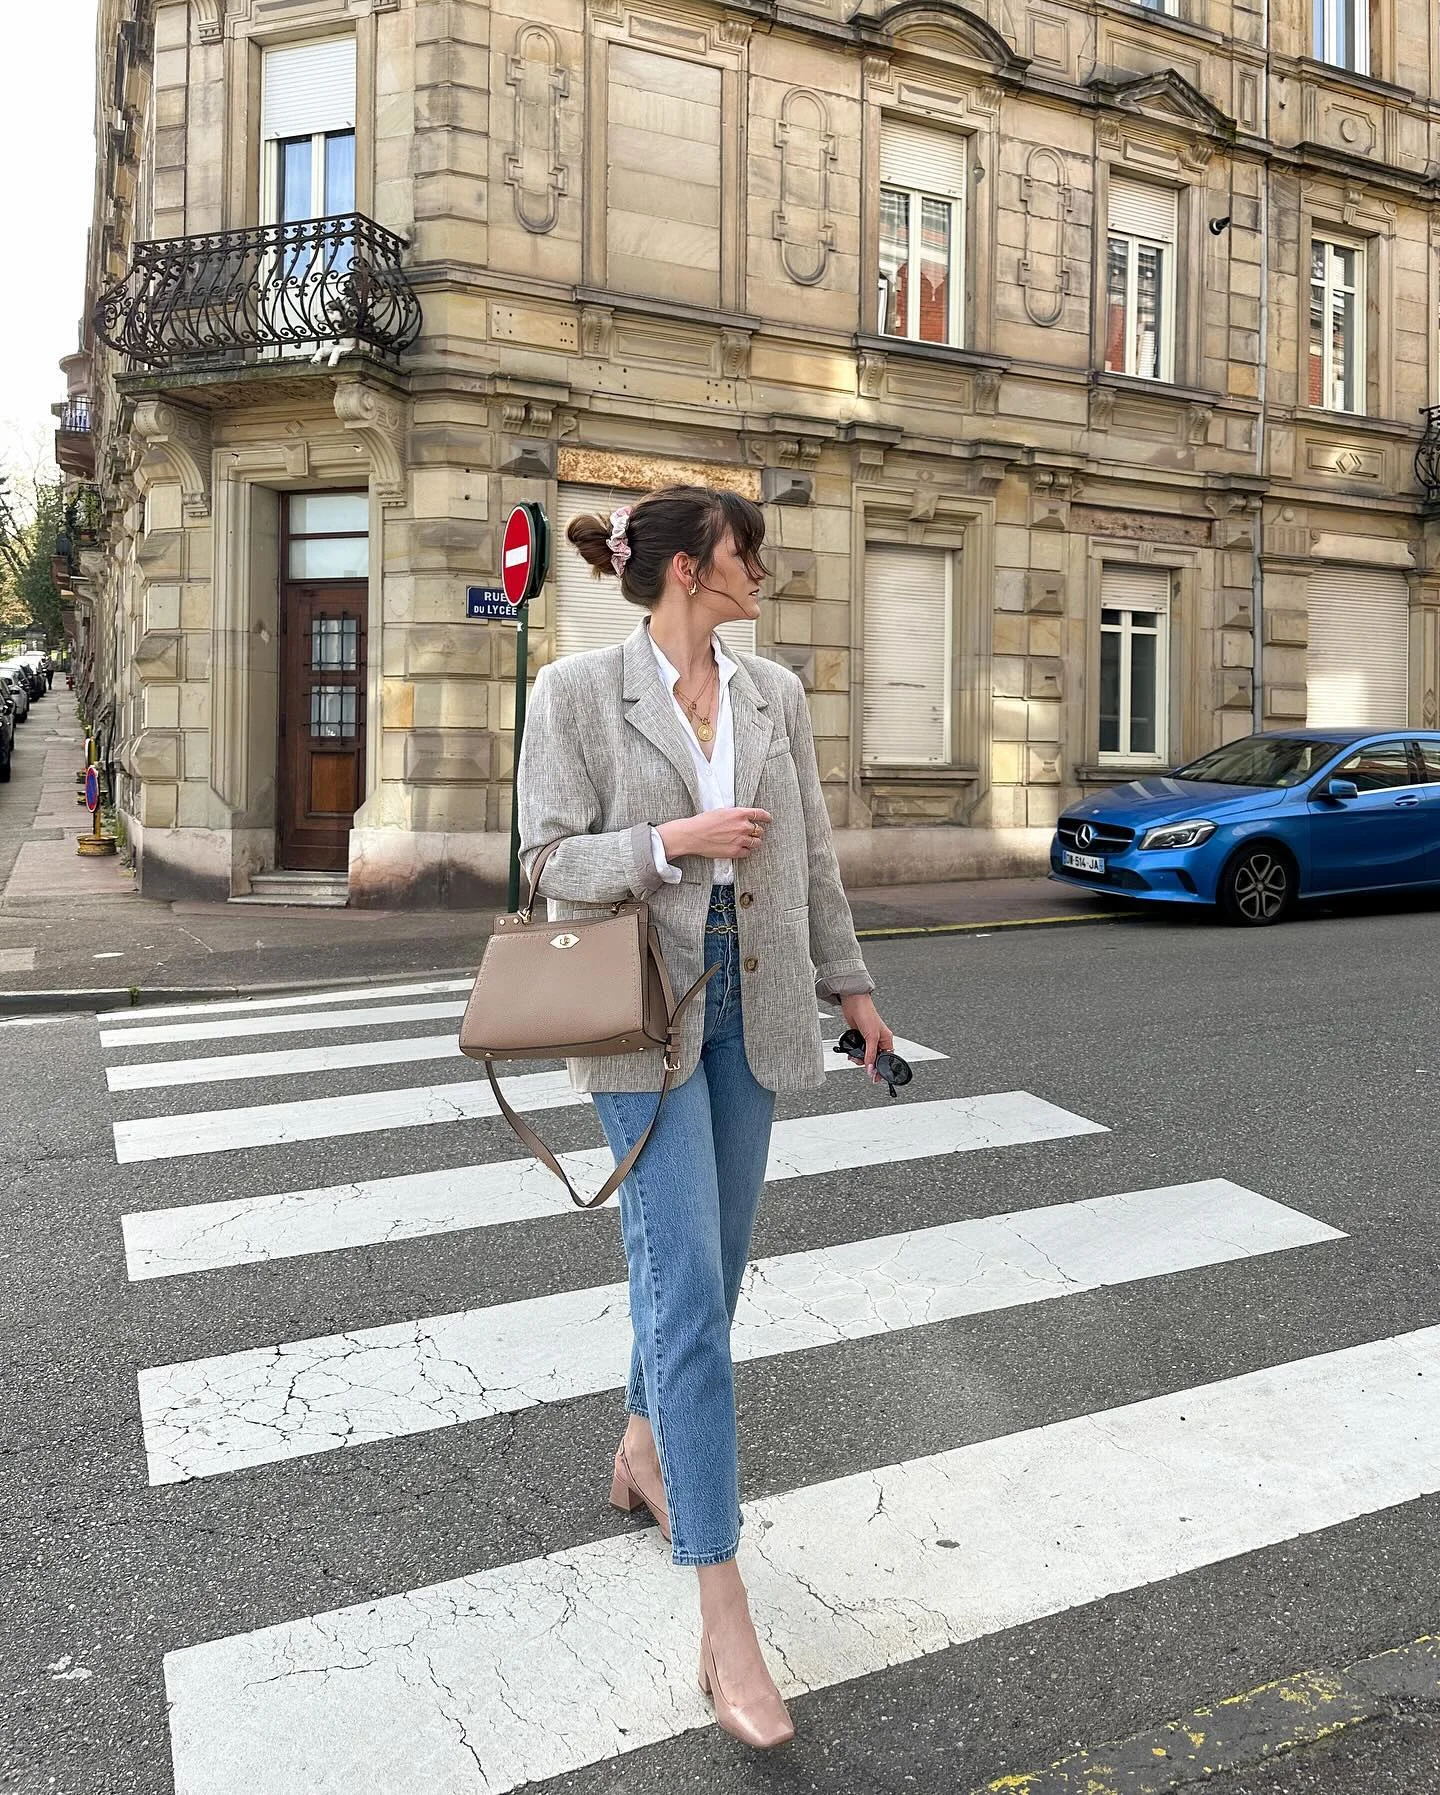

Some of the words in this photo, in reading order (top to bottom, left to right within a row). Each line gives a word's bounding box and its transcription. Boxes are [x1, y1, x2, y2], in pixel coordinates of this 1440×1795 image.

[484, 592, 507, 602] RUE
[474, 605, 485, 613] DU
[487, 604, 517, 615] LYCÉE
